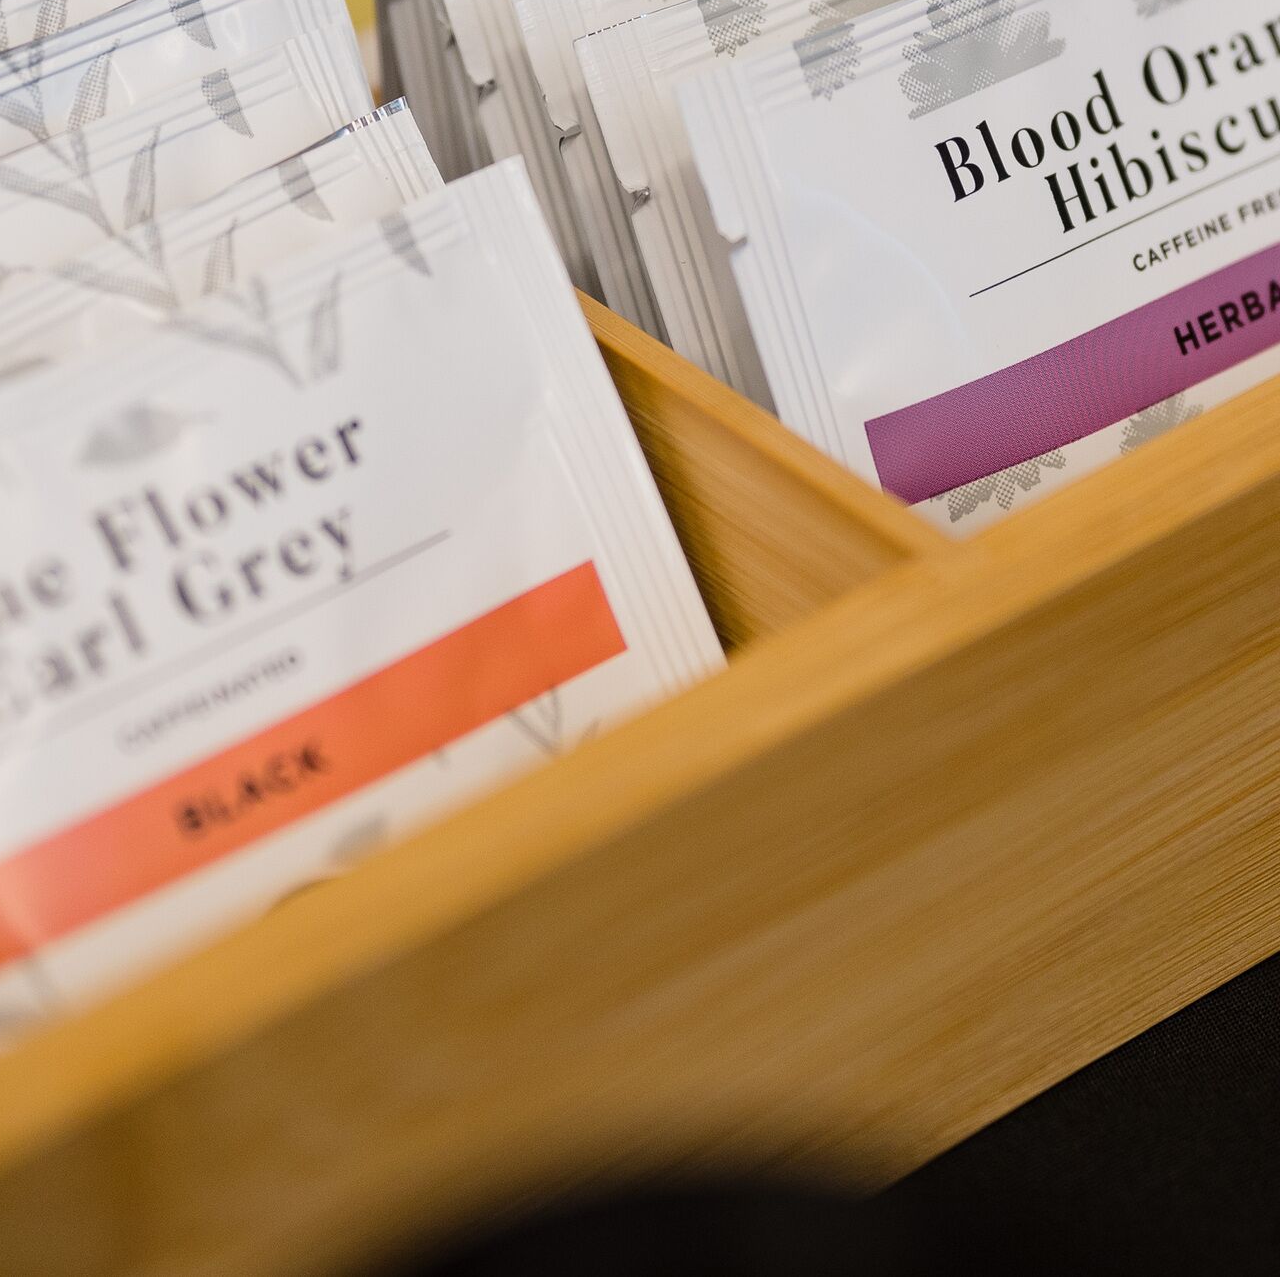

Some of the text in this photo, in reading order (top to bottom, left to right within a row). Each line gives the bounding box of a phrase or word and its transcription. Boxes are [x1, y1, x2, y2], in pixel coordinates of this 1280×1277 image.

[934, 70, 1124, 202] Blood
[1131, 213, 1232, 273] CAFFEINE
[90, 415, 366, 573] Flower
[171, 505, 357, 628] Grey
[176, 739, 334, 841] BLACK
